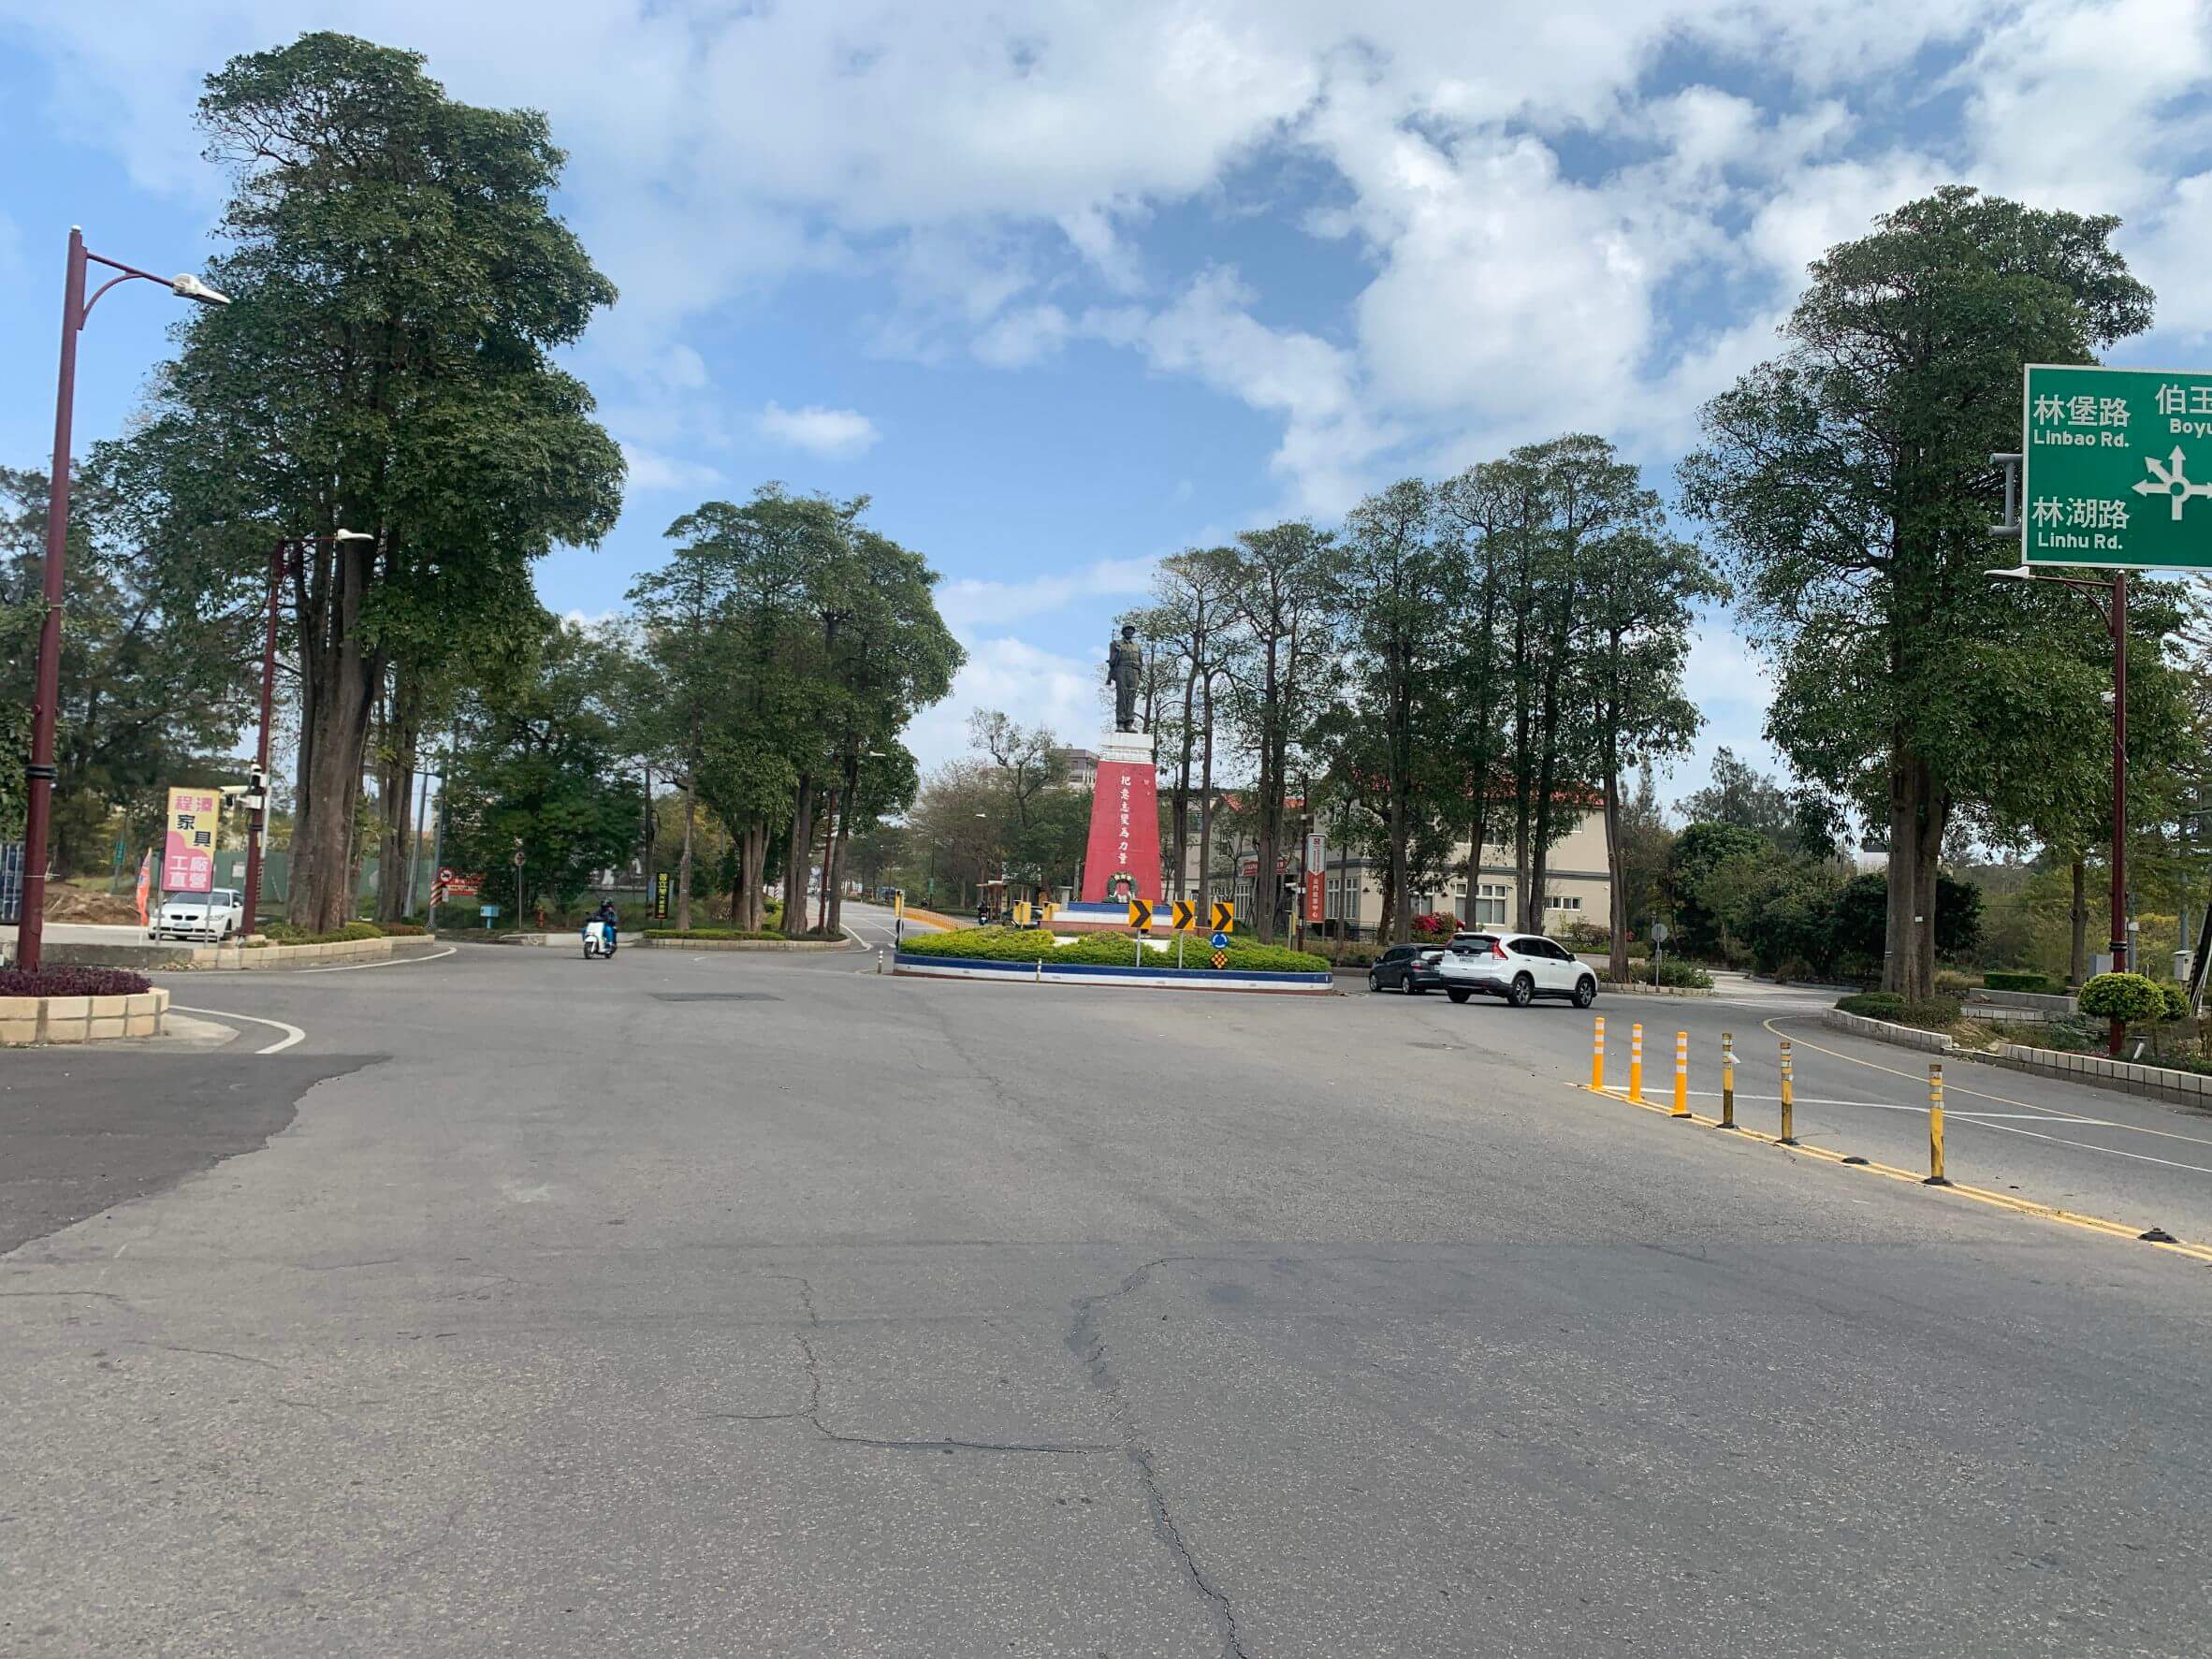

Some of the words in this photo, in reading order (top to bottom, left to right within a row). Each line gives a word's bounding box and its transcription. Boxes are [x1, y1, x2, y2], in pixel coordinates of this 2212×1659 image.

[2033, 394, 2132, 428] 林堡路
[2033, 429, 2096, 447] Linbao
[2101, 432, 2131, 448] Rd.
[2031, 496, 2131, 530] 林湖路
[2037, 532, 2089, 549] Linhu
[2094, 534, 2124, 550] Rd.
[177, 815, 211, 847] 家具
